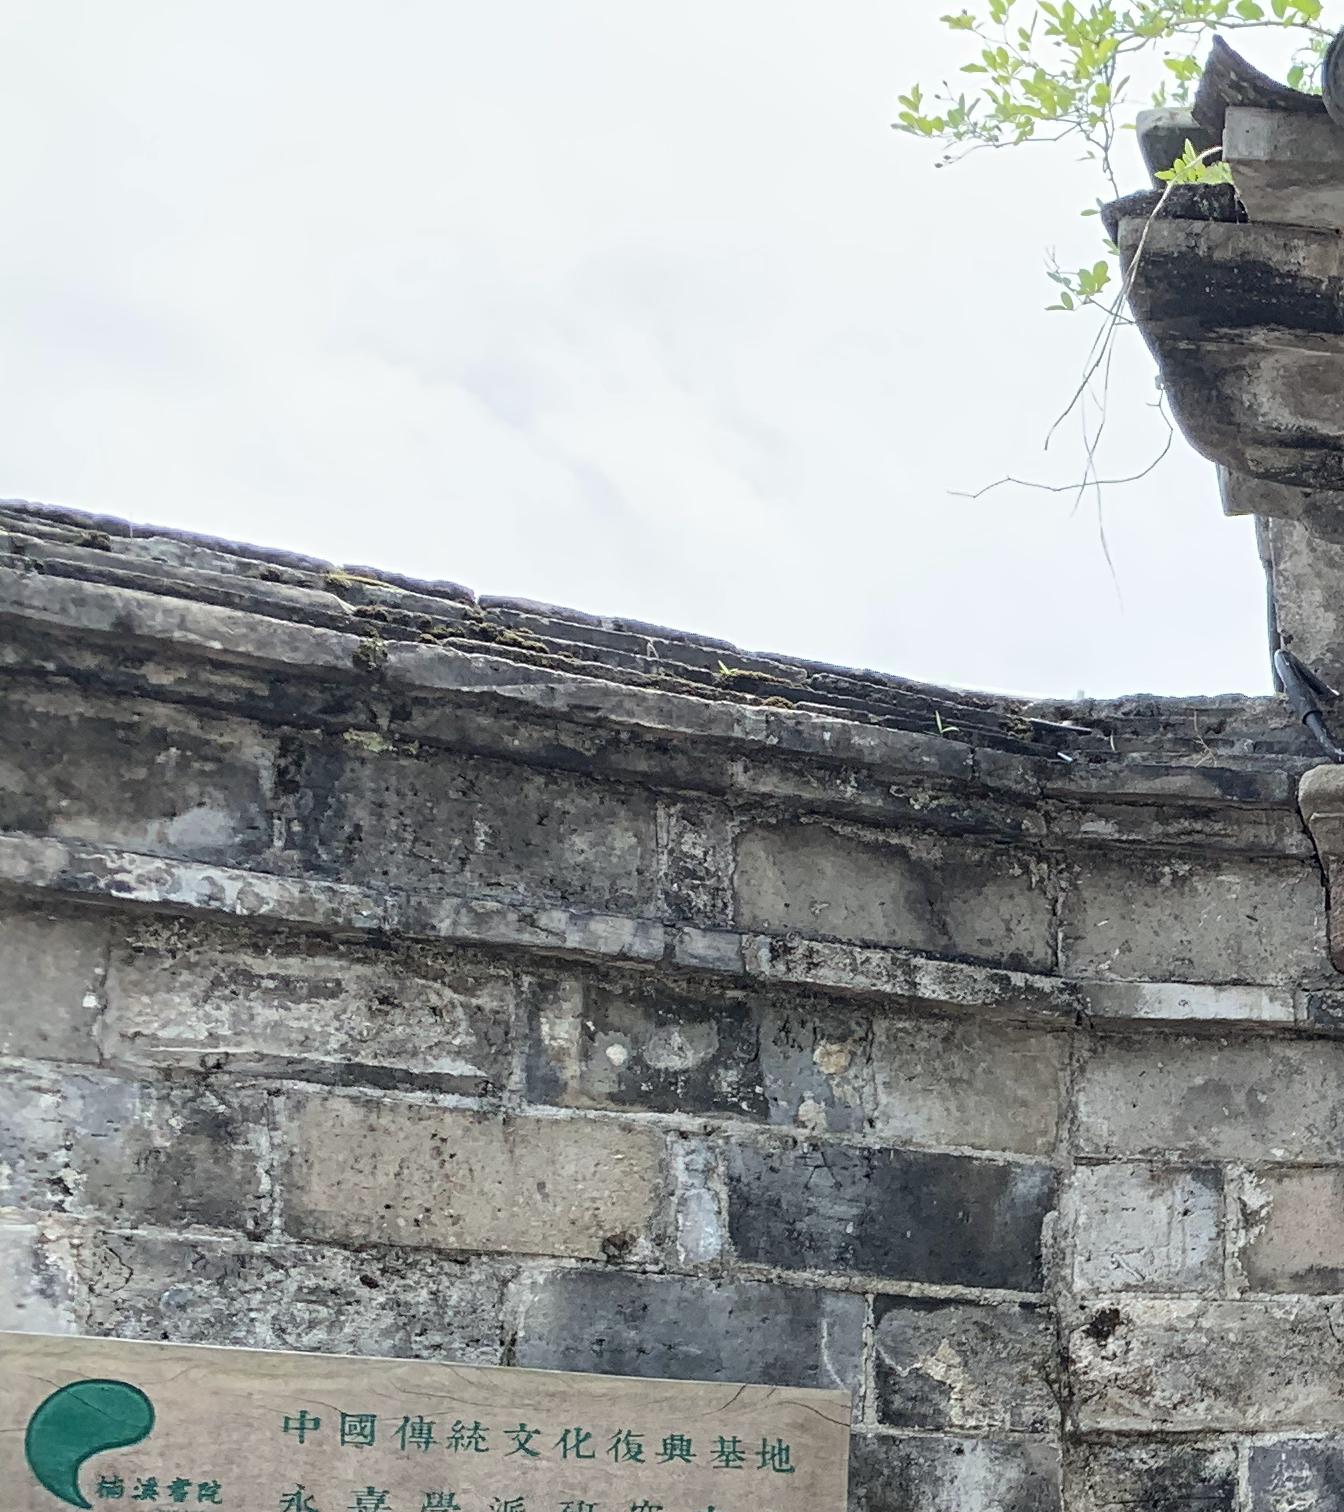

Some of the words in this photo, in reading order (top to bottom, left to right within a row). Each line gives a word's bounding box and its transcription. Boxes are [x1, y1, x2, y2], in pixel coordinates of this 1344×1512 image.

[281, 1409, 795, 1475] 中國傳統文化復興基地
